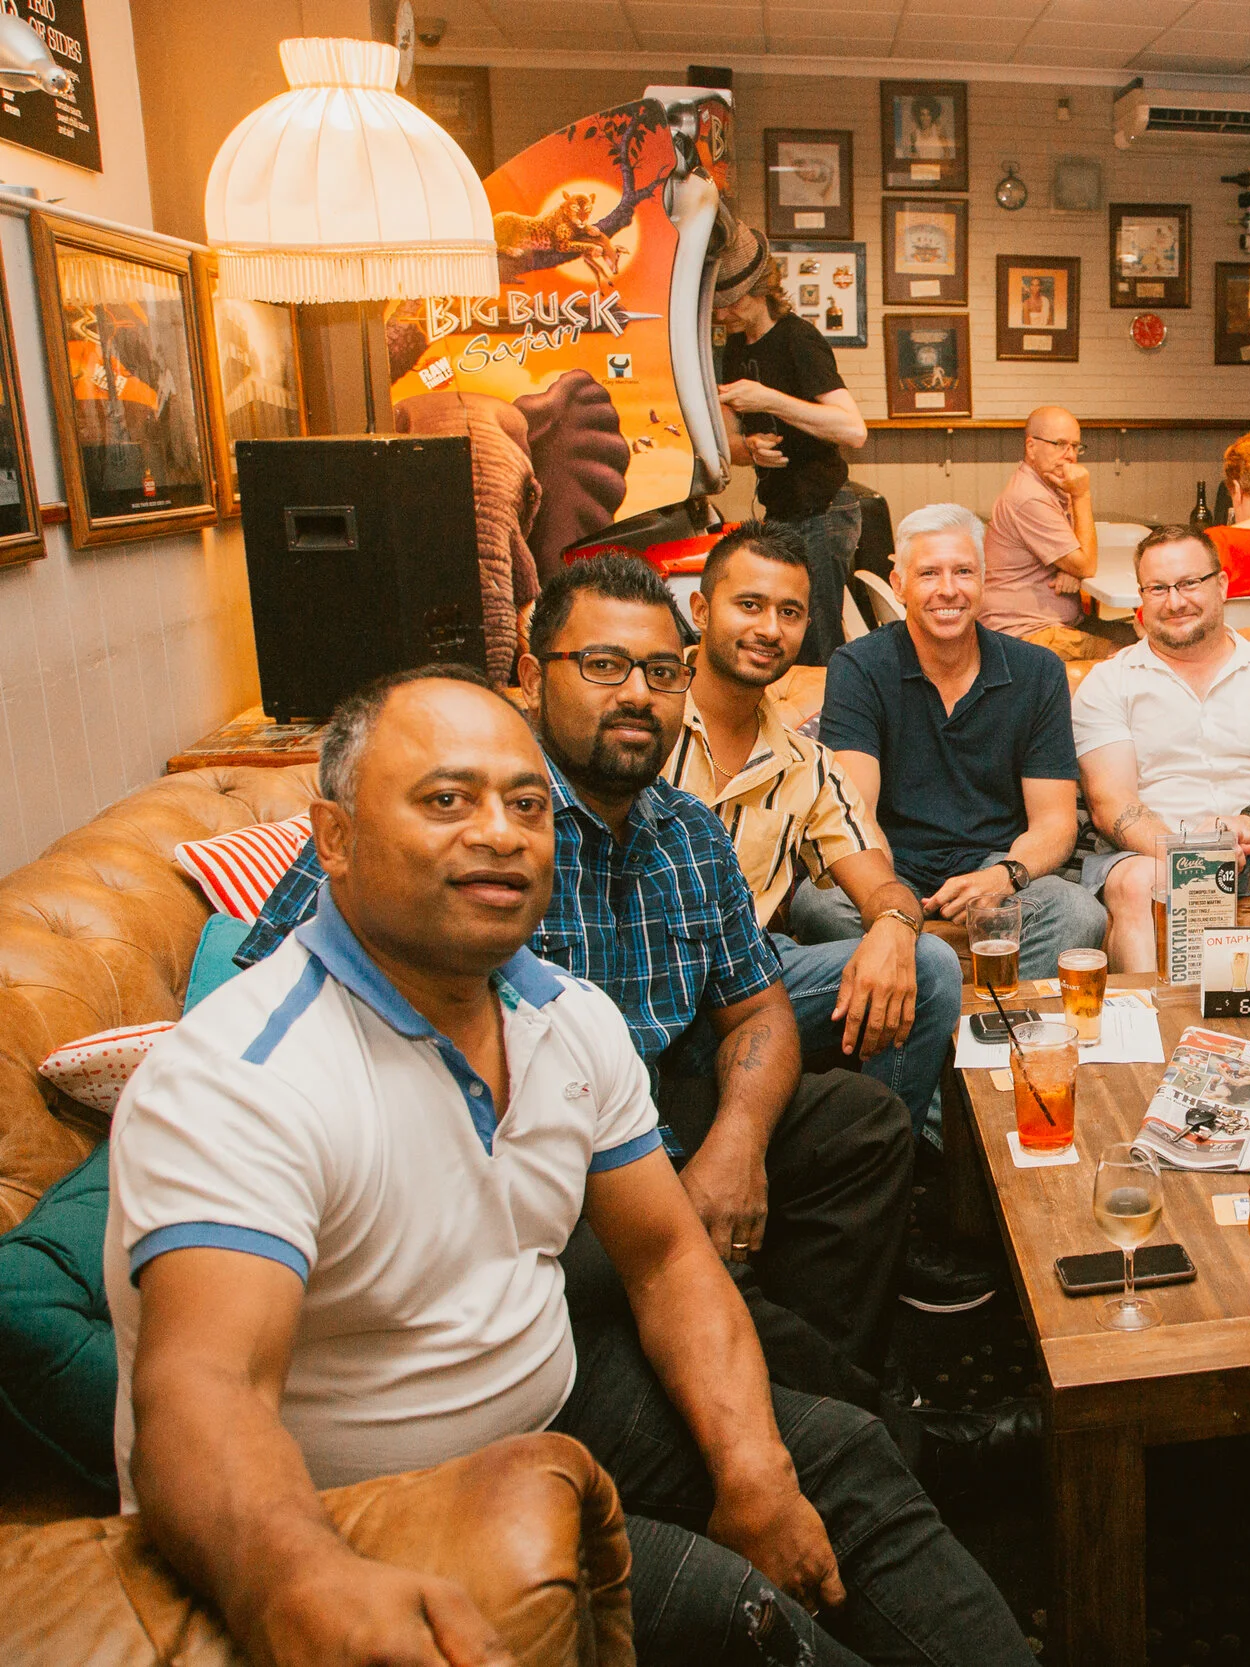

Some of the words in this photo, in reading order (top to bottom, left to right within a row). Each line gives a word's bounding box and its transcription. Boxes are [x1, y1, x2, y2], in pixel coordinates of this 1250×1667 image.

[46, 26, 83, 64] SIDES
[427, 294, 500, 343] BIG
[506, 290, 624, 338] BUCK
[457, 319, 589, 372] Safari
[418, 357, 452, 383] RAW
[1176, 856, 1206, 871] Civic
[1222, 869, 1235, 882] $12
[1171, 907, 1188, 983] COCKTAILS
[1206, 937, 1222, 947] ON
[1225, 935, 1243, 945] TAP
[1225, 999, 1230, 1007] $
